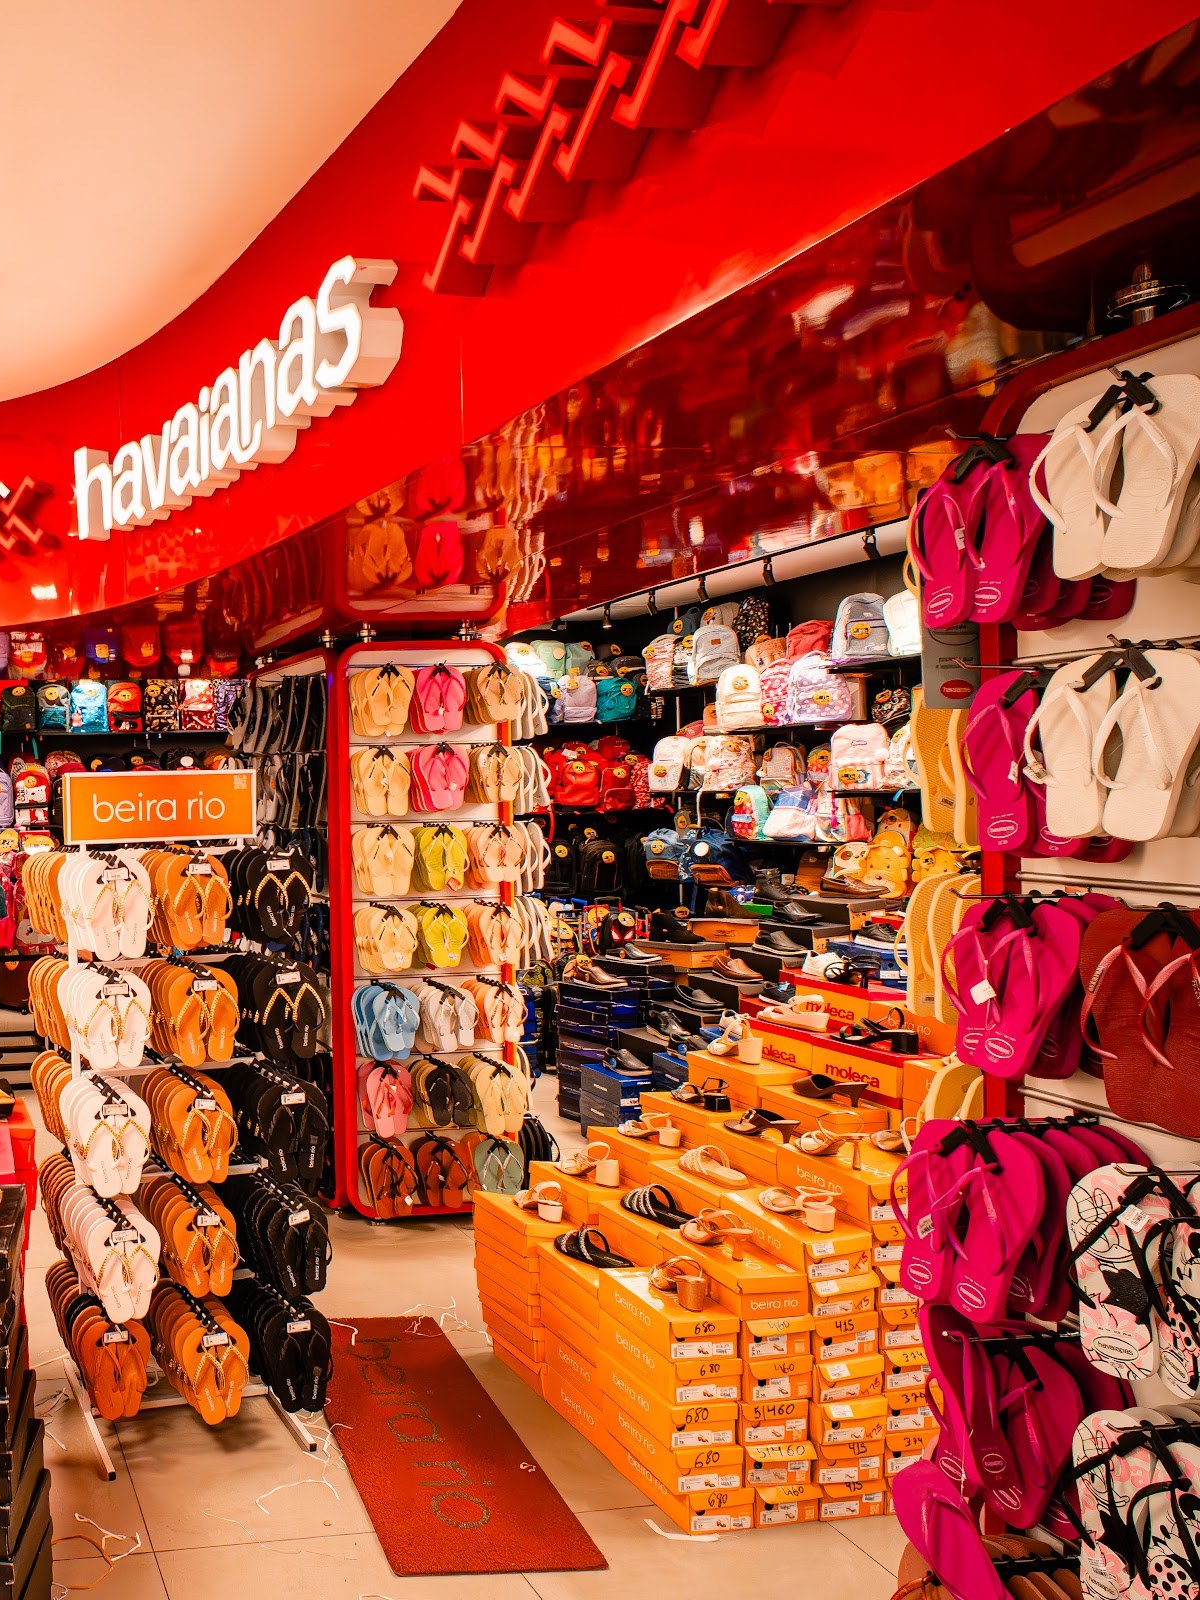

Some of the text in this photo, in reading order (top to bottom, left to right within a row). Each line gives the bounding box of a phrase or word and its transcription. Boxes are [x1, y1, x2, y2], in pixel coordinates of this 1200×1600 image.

[73, 254, 400, 541] havaianas
[93, 791, 226, 823] beira rio
[917, 1021, 931, 1035] rio
[761, 1044, 796, 1063] oleca
[826, 1062, 880, 1089] moleca
[796, 1165, 843, 1195] beira rio
[767, 1233, 782, 1250] rio
[614, 1291, 651, 1326] beira rio
[750, 1298, 799, 1310] beira rio
[835, 1321, 855, 1332] 415
[616, 1330, 655, 1369] beira rio
[1097, 1341, 1134, 1356] havaianas
[558, 1346, 591, 1382] beira rio
[700, 1363, 720, 1376] 680
[612, 1371, 650, 1412] beira rio
[560, 1388, 595, 1426] beira rio
[685, 1407, 709, 1424] 680
[618, 1412, 656, 1455] beira rio
[627, 1452, 668, 1495] beira rio
[695, 1451, 720, 1468] 680
